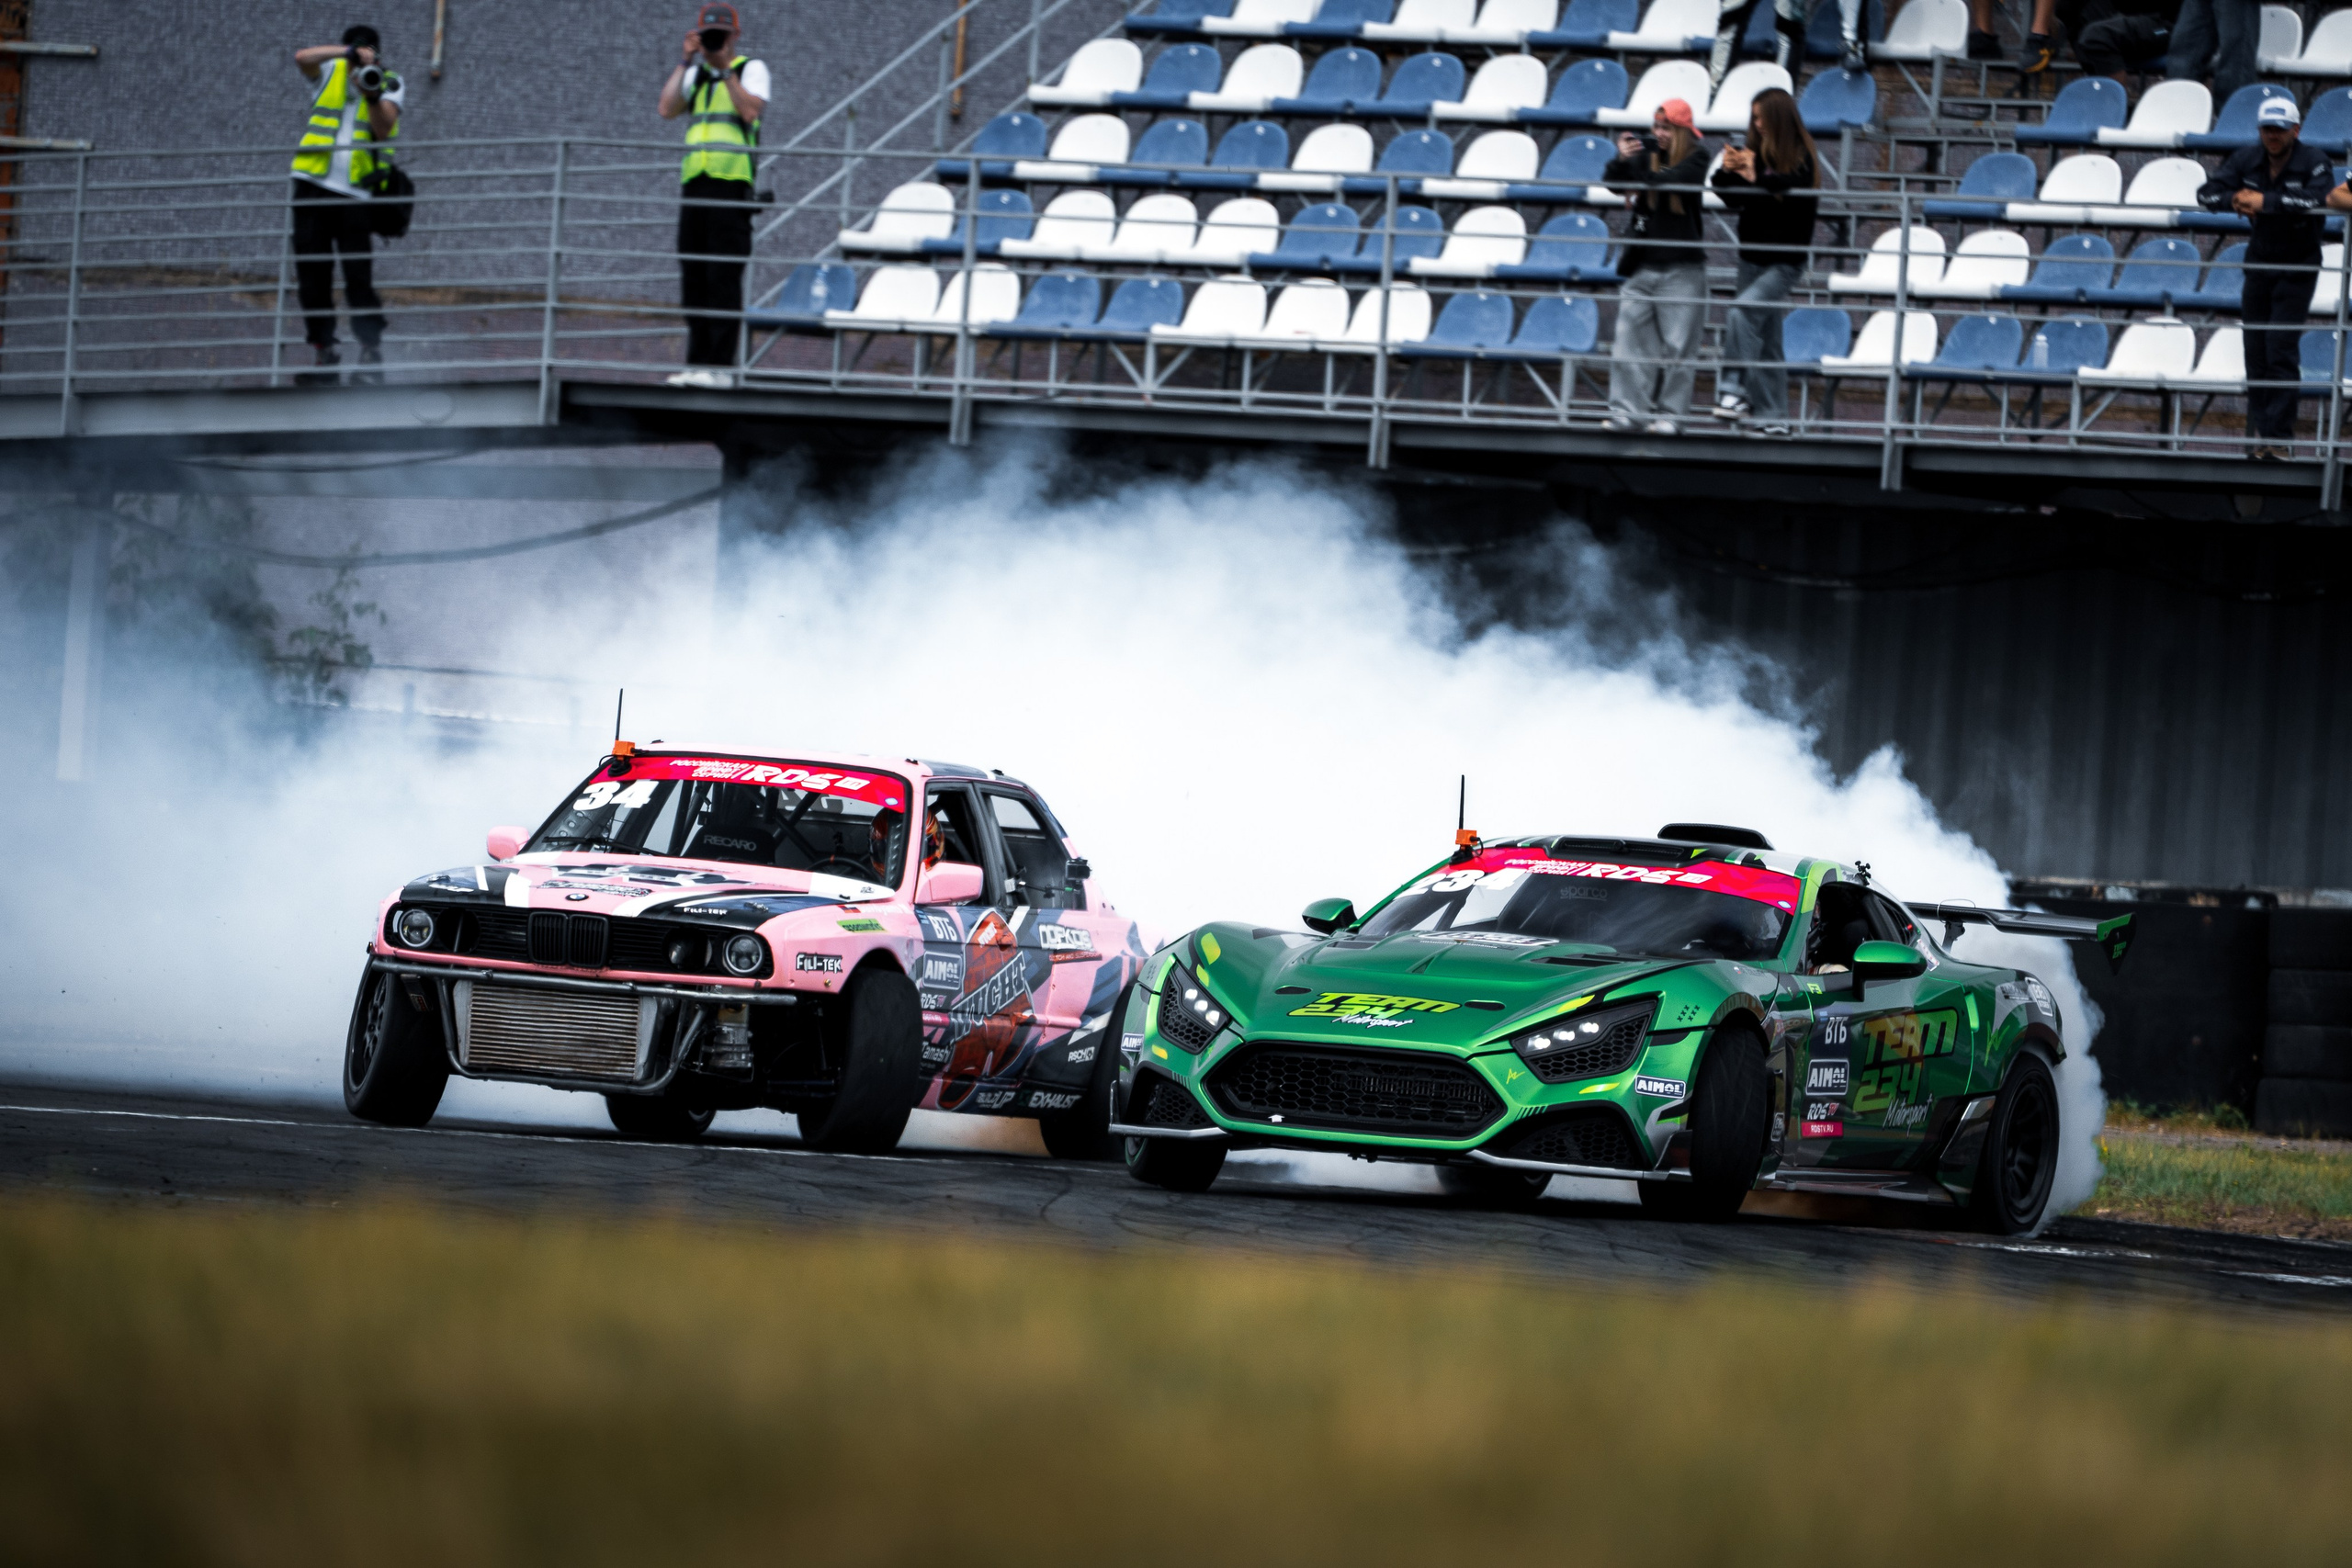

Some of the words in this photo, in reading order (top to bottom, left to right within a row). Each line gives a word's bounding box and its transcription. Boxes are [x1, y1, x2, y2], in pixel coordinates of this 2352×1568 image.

[741, 764, 842, 790] RDS
[573, 779, 660, 811] 34
[704, 835, 757, 851] RECARO
[1393, 868, 1527, 900] 234
[1577, 863, 1685, 884] RDS
[1560, 886, 1608, 900] sparco
[927, 915, 957, 942] ВТБ
[796, 953, 843, 974] FILI-TEK
[924, 959, 959, 983] AIMOL
[1313, 992, 1463, 1014] TEAM
[1825, 1016, 1849, 1044] ВТБ
[1862, 1009, 1959, 1066] TEAM
[1637, 1079, 1682, 1095] AIMOL
[1808, 1067, 1848, 1089] AIMOL
[1852, 1062, 1924, 1114] 234
[1806, 1102, 1830, 1121] RDS
